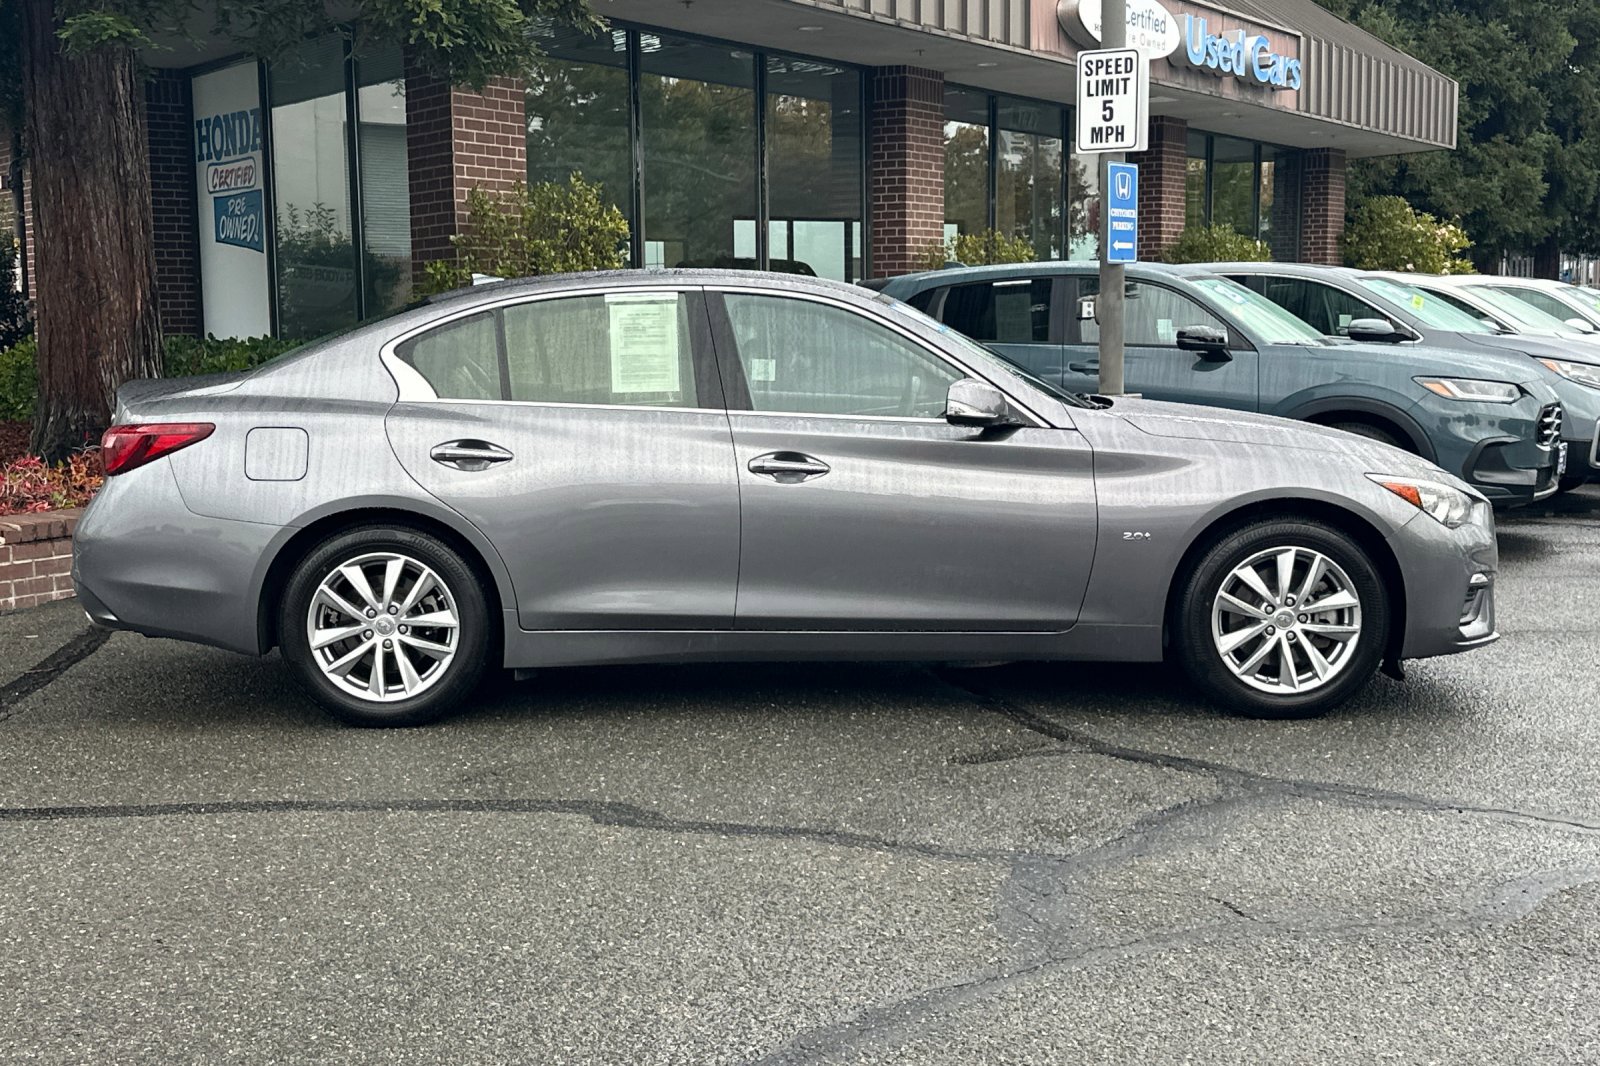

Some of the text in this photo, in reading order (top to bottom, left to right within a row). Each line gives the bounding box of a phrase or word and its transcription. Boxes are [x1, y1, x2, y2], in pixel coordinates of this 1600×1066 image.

[1185, 14, 1301, 91] Used Cars
[1084, 57, 1134, 77] SPEED
[1086, 78, 1131, 98] LIMIT
[1101, 100, 1114, 123] 5
[195, 108, 263, 162] HONDA
[1090, 125, 1125, 145] MPH
[211, 164, 254, 189] CERTIFIED
[227, 197, 247, 216] PRE
[219, 213, 260, 242] OWNED!
